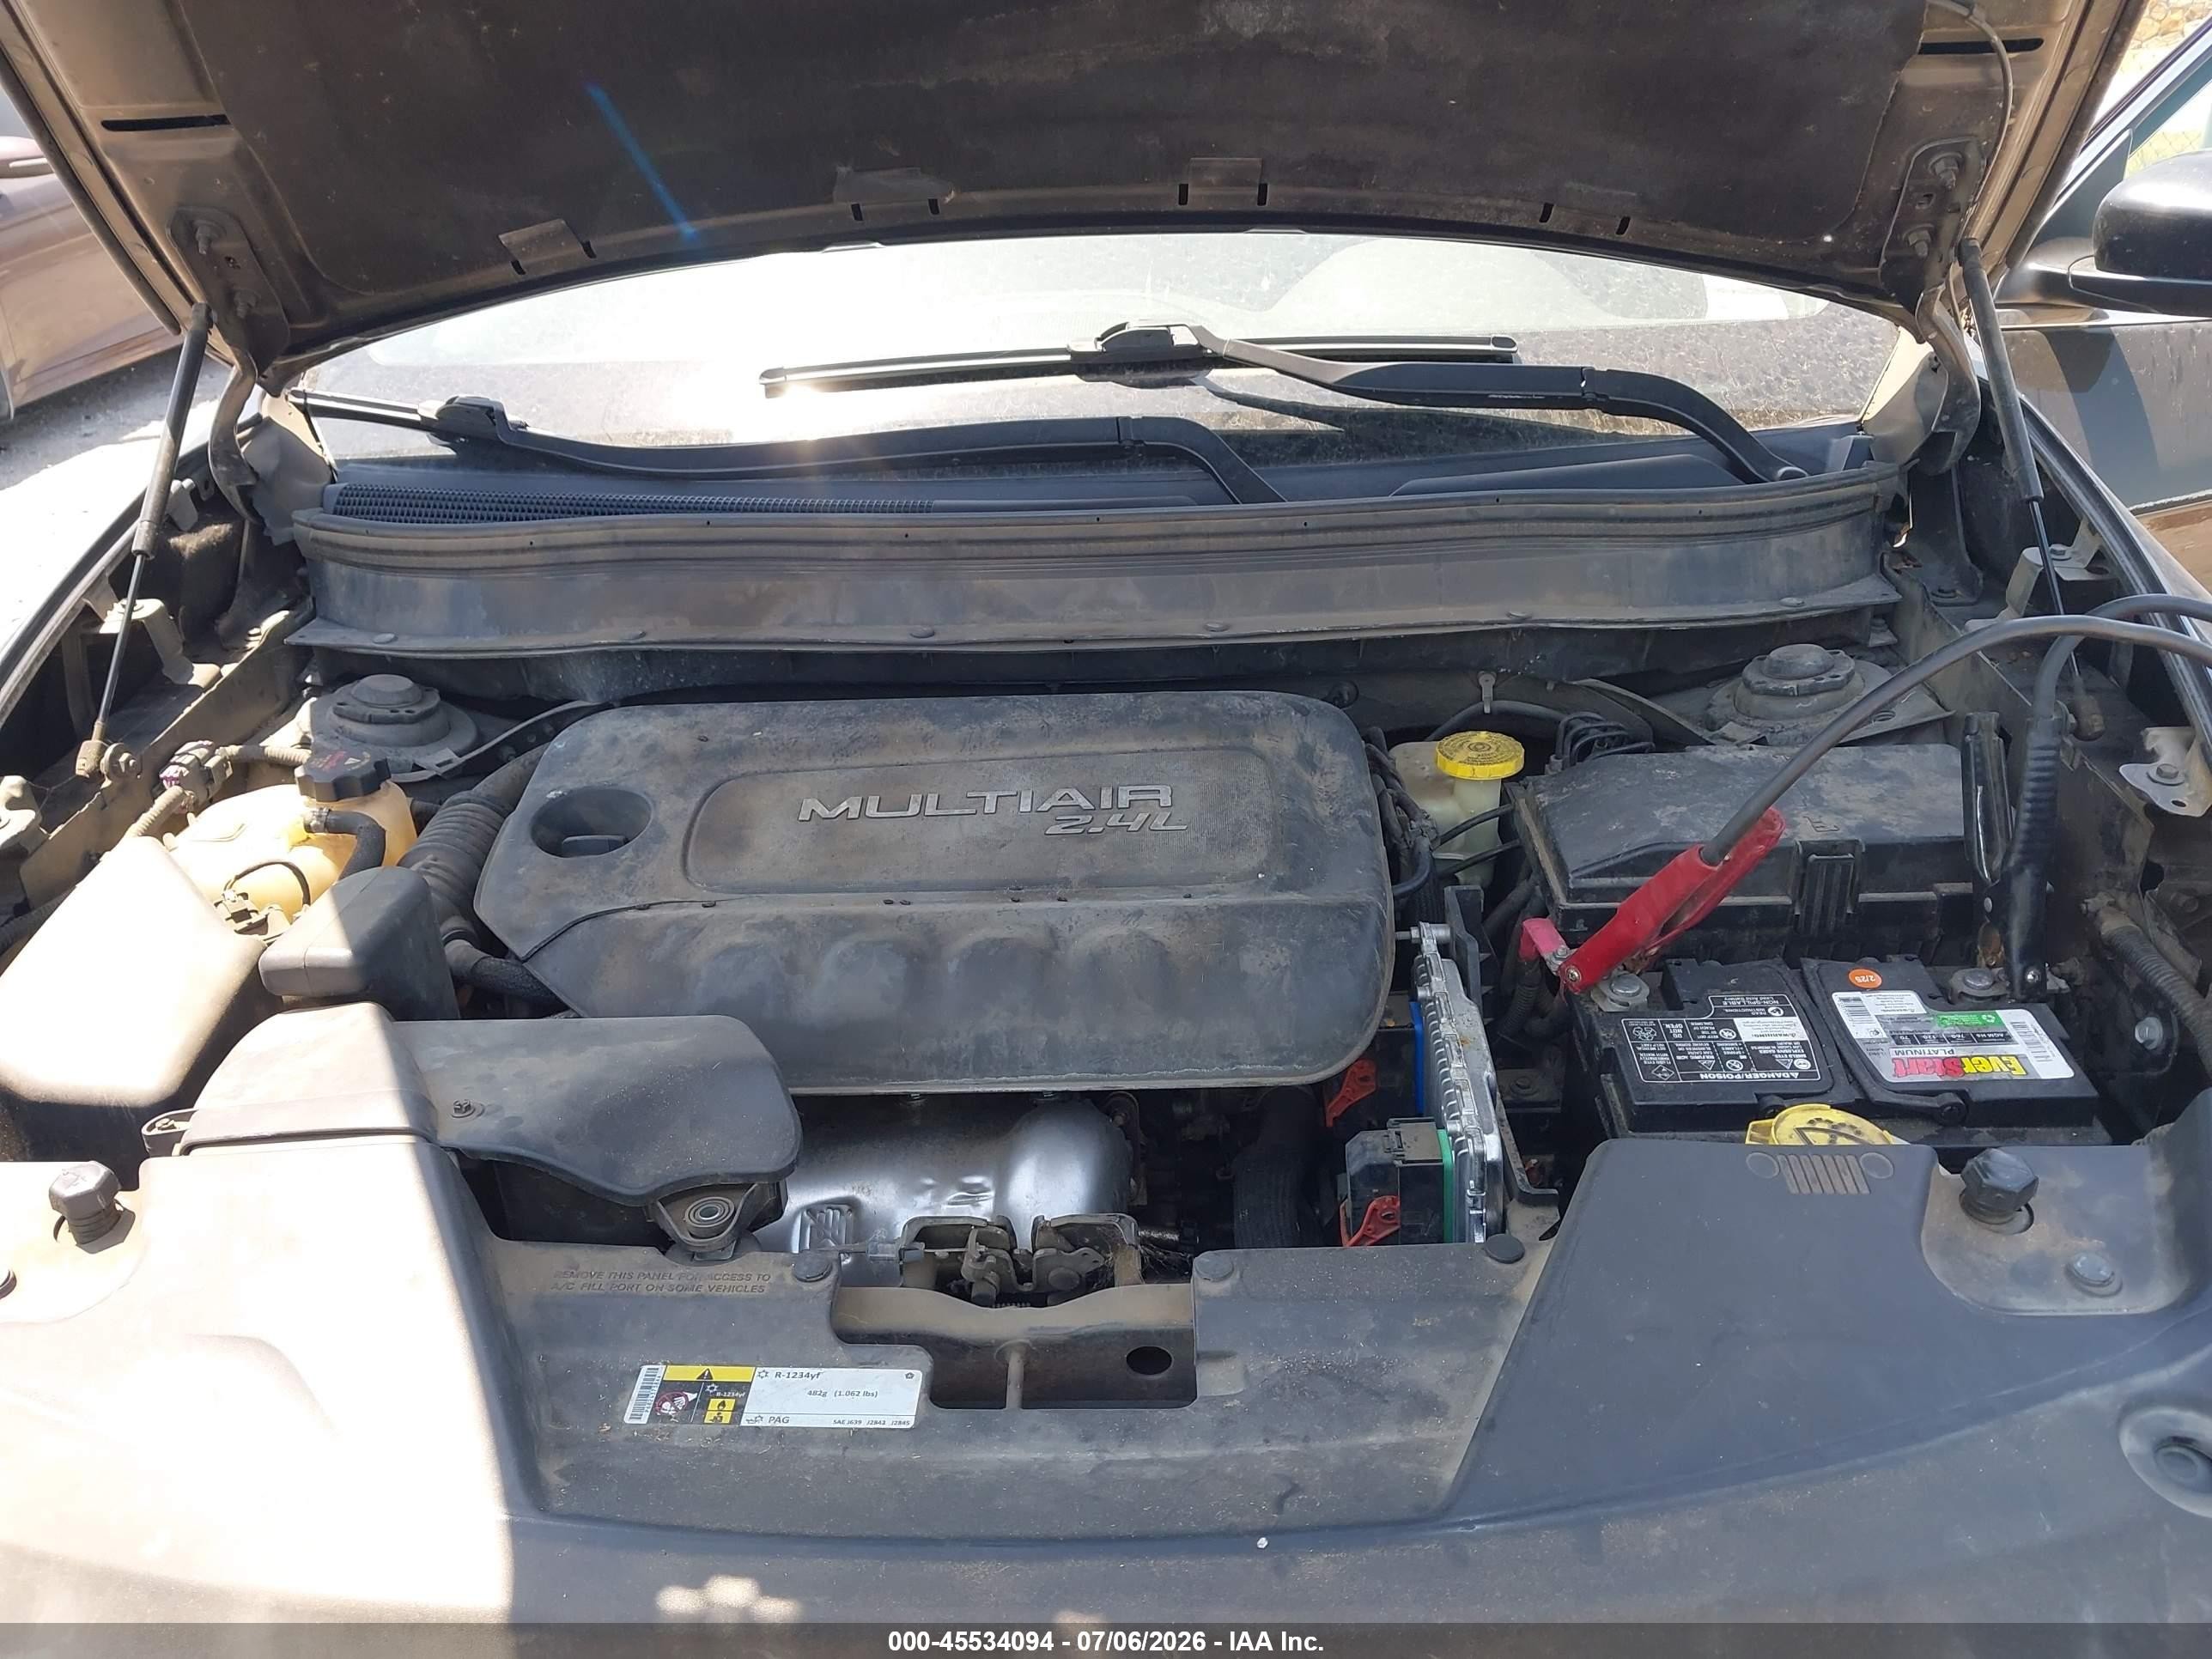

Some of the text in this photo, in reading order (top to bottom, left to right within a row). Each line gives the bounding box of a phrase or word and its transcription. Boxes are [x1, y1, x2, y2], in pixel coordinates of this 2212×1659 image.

[798, 783, 1173, 822] MULTIAIR
[1044, 811, 1188, 836] 2.4L
[1855, 974, 1876, 983] 2/25
[1892, 1054, 2027, 1078] EverStart
[608, 1272, 635, 1280] THIS
[637, 1272, 674, 1280] PANEL
[757, 1273, 771, 1282] TO
[580, 1282, 605, 1291] FILL
[610, 1283, 641, 1292] PORT
[645, 1283, 663, 1292] ON
[667, 1284, 703, 1293] SOME
[708, 1284, 765, 1293] VEHICLES
[775, 1372, 821, 1381] R-1234yf
[807, 1390, 878, 1398] 482g (1.062 lbs)
[768, 1416, 790, 1424] PAG
